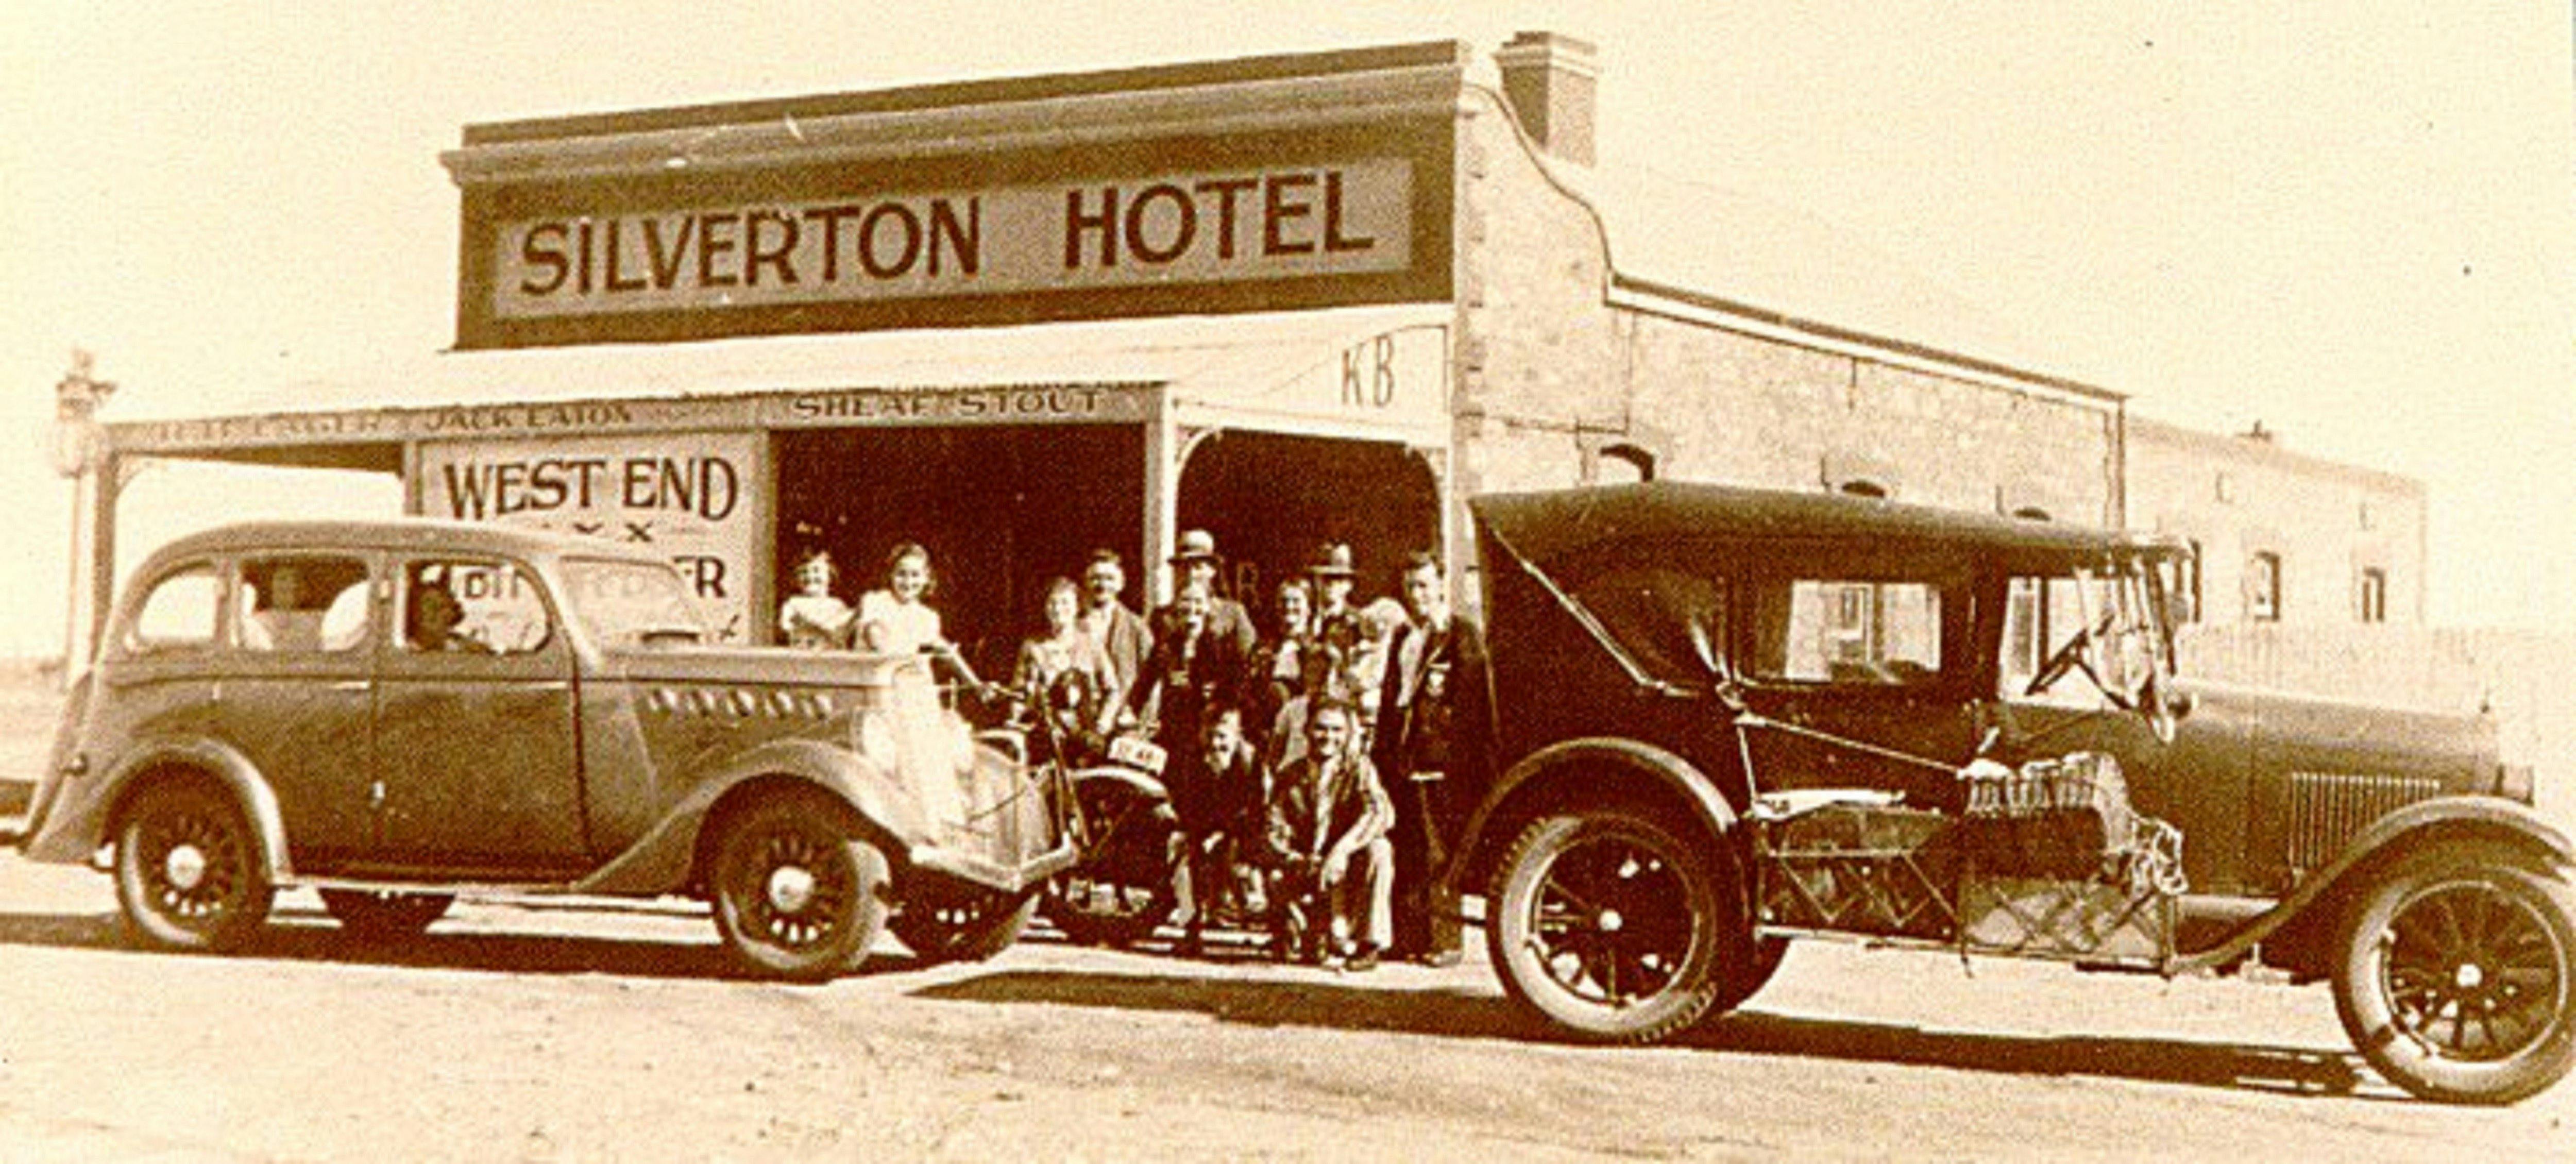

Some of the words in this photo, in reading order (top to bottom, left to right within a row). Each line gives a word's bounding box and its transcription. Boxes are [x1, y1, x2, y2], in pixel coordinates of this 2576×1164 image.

[519, 197, 980, 296] SILVERTON
[1064, 171, 1375, 269] HOTEL
[1342, 333, 1394, 407] KB
[425, 405, 512, 431] JACK
[527, 401, 632, 428] EATON
[793, 395, 929, 417] SHEAF
[958, 390, 1099, 416] STOUT
[443, 460, 607, 520] WEST
[622, 457, 739, 521] END
